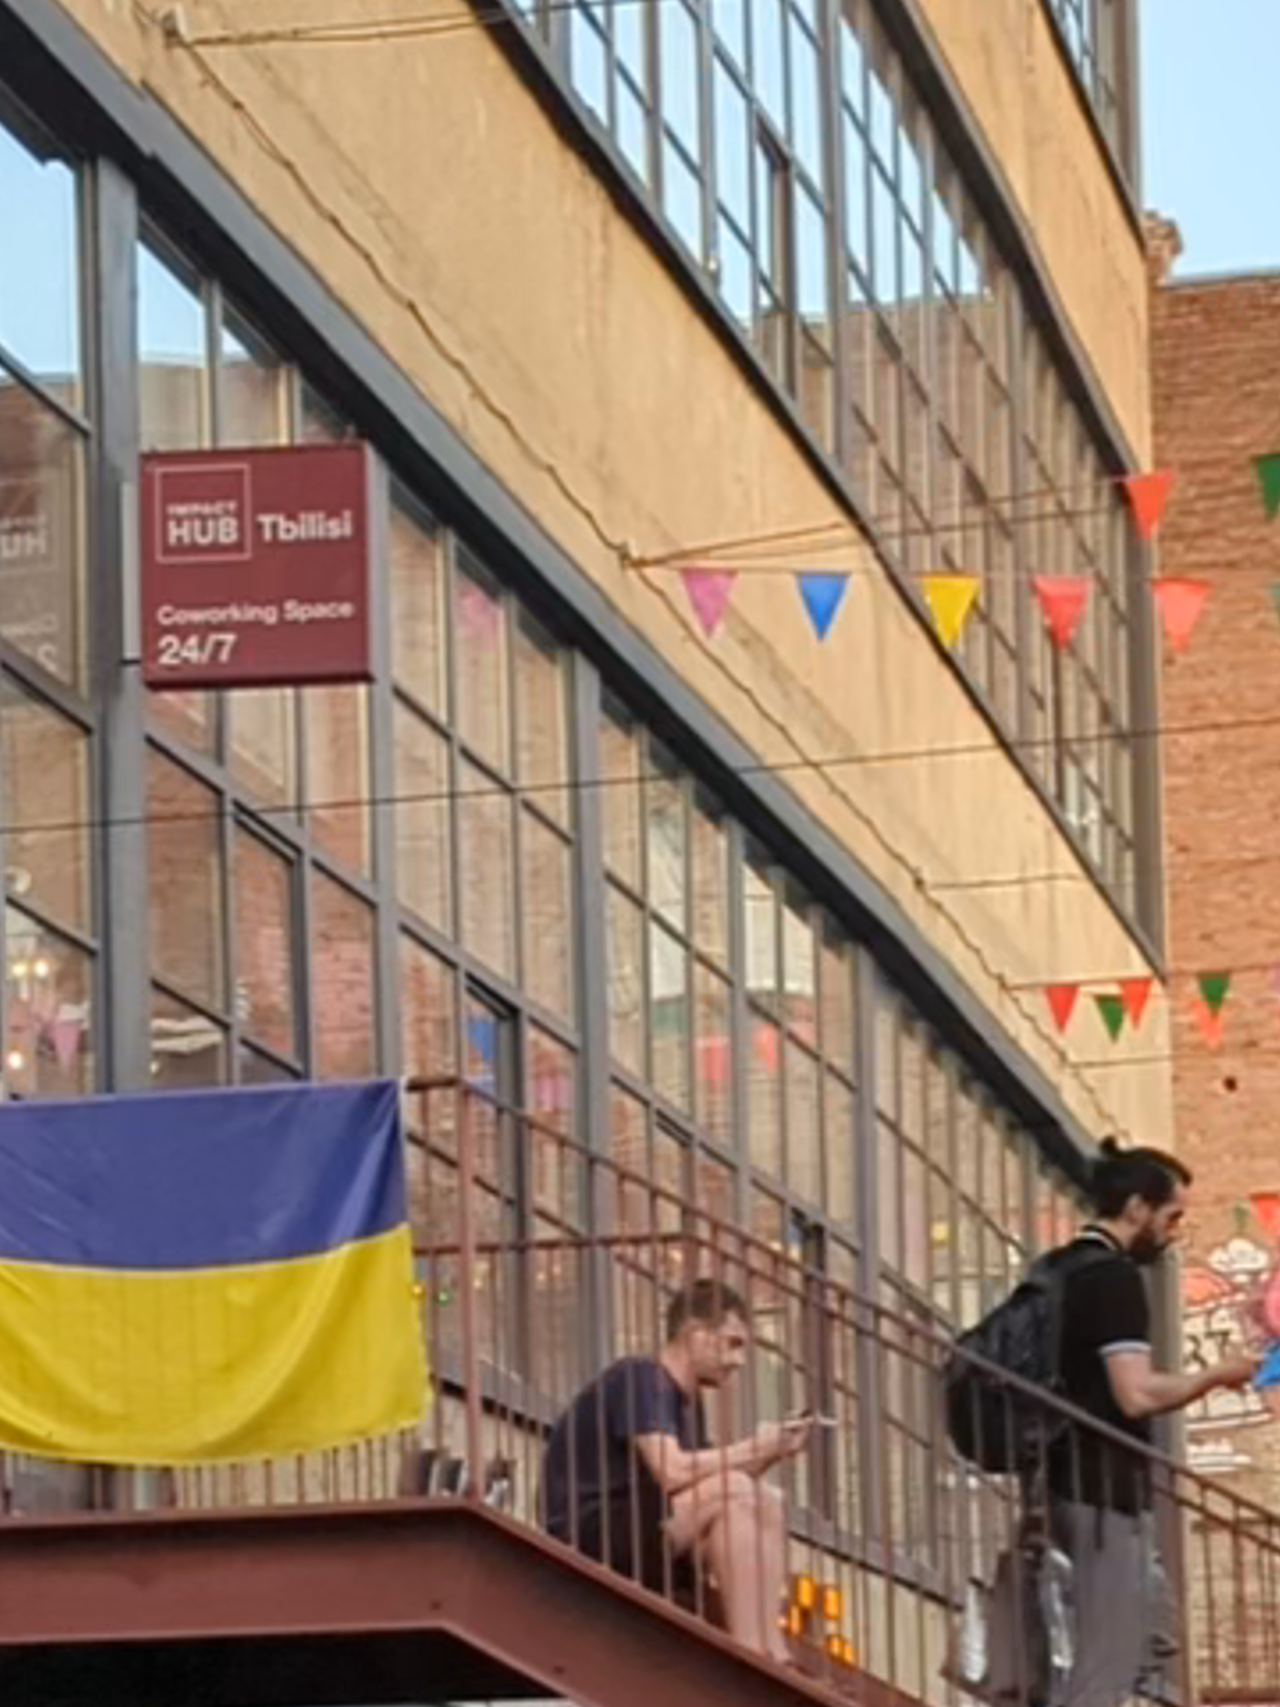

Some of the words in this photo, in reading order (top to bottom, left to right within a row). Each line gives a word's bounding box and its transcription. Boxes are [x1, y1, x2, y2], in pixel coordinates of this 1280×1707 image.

[166, 500, 238, 516] IMPACT
[167, 516, 239, 547] HUB
[257, 510, 352, 542] Tbilisi
[156, 602, 278, 626] Coworking
[282, 599, 354, 622] Space
[157, 633, 237, 666] 24/7
